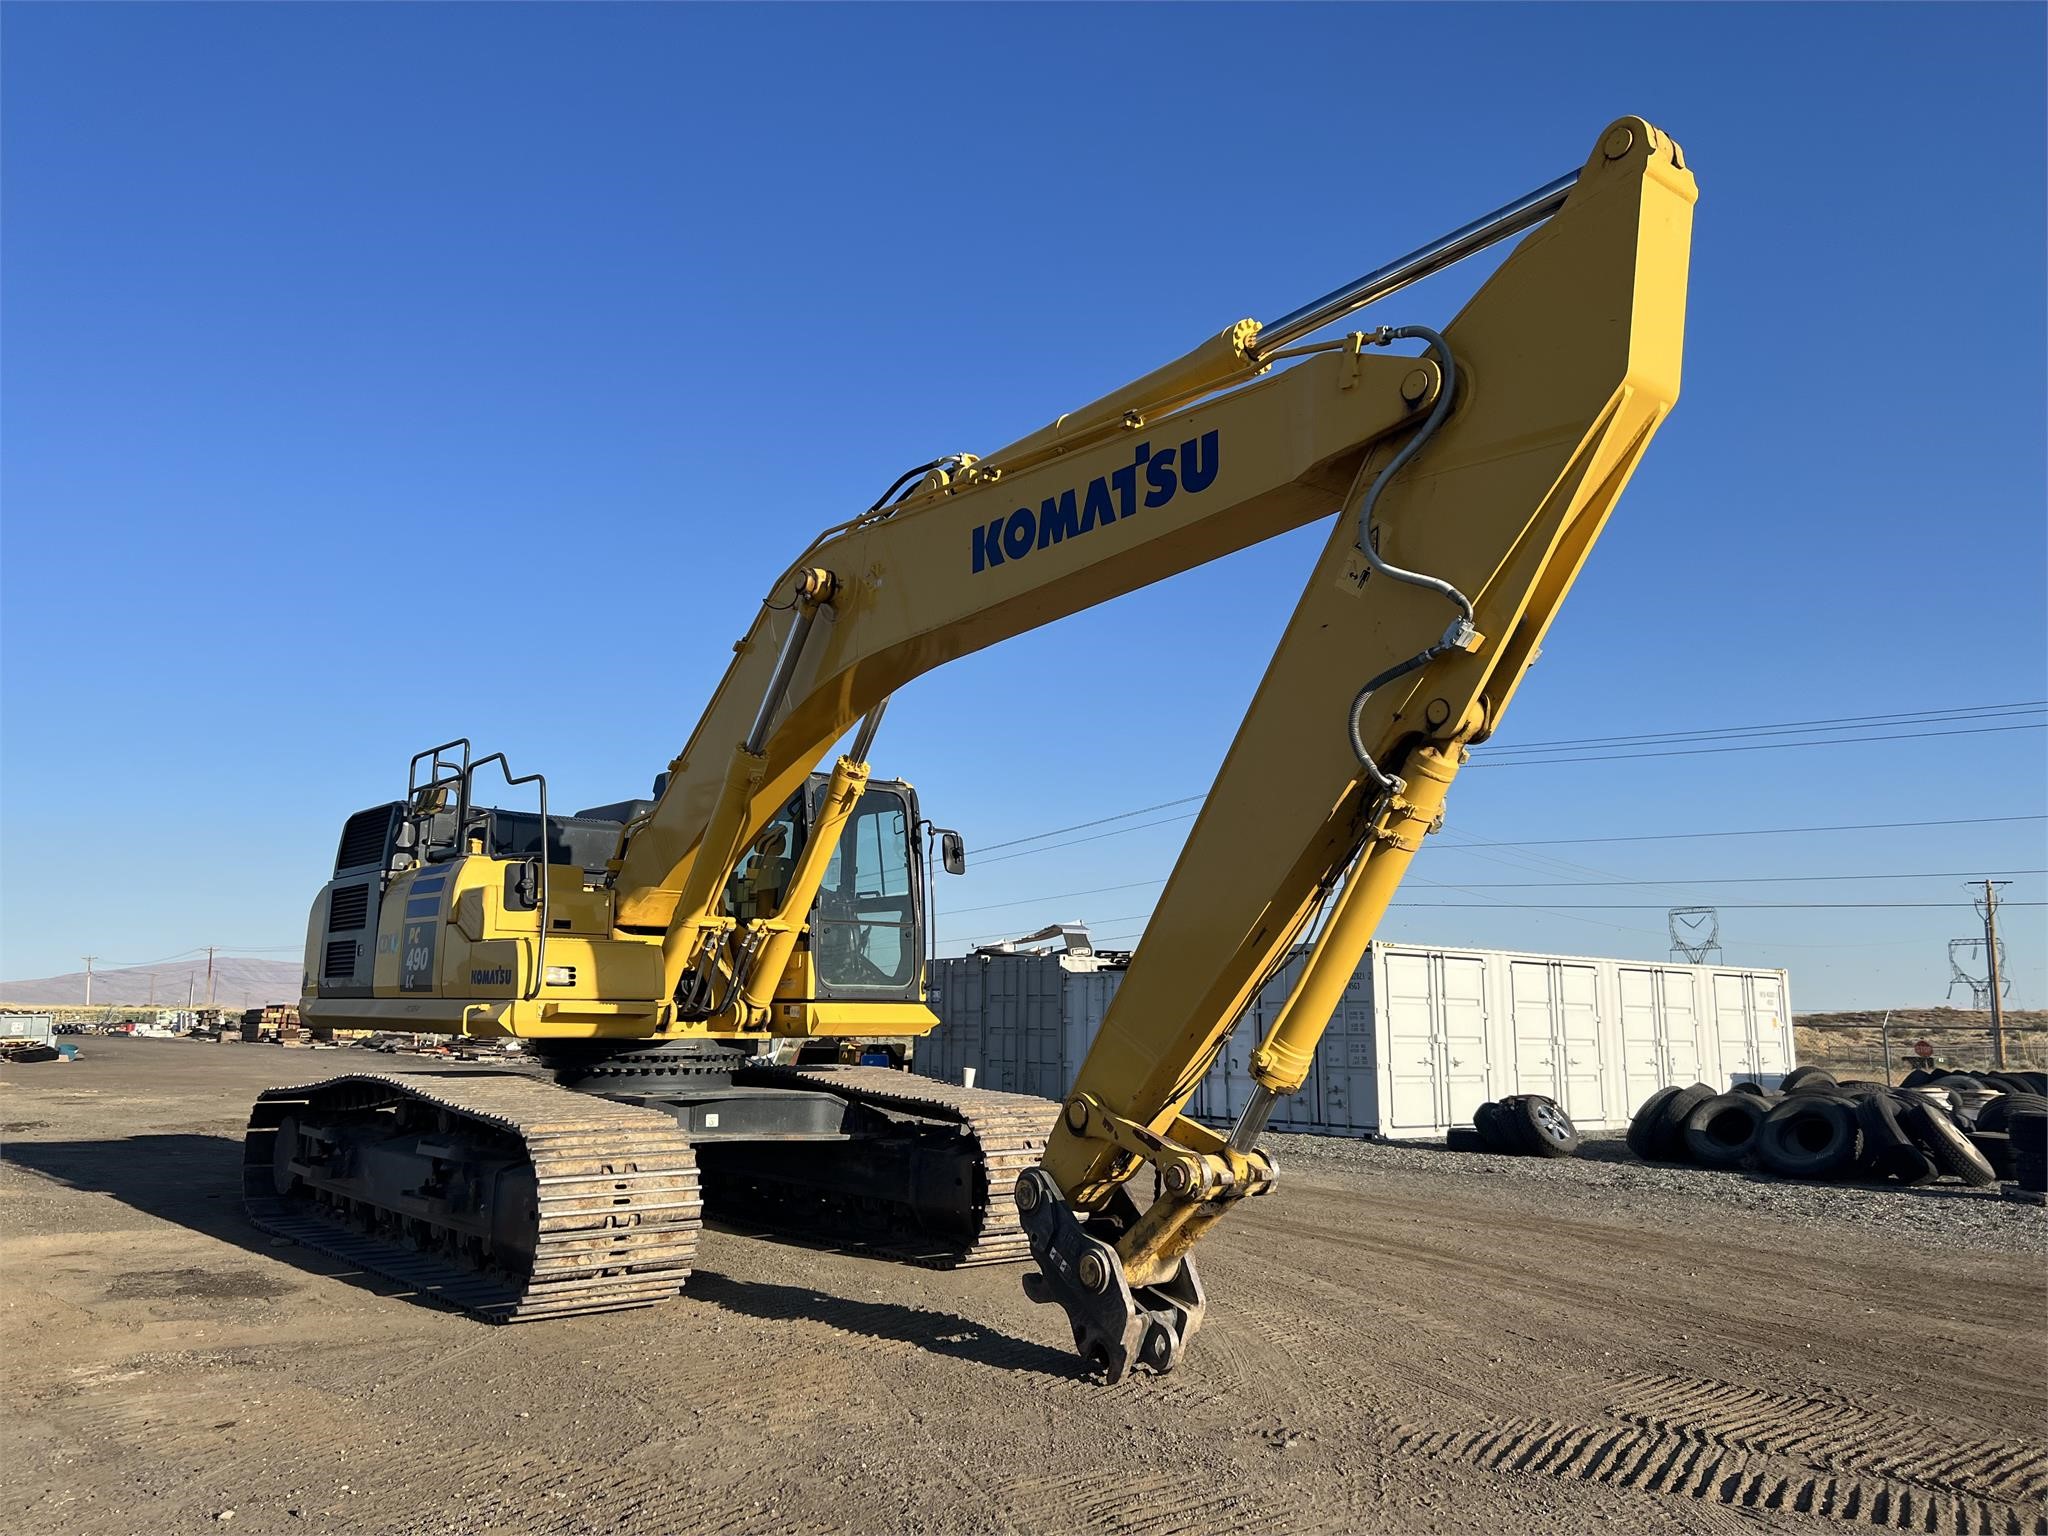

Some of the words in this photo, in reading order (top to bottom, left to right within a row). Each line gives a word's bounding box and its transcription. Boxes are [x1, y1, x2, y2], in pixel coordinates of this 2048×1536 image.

[972, 429, 1219, 574] KOMATSU
[409, 927, 421, 944] PC
[406, 947, 429, 971] 490
[405, 974, 415, 989] LC
[471, 965, 512, 984] KOMATSU
